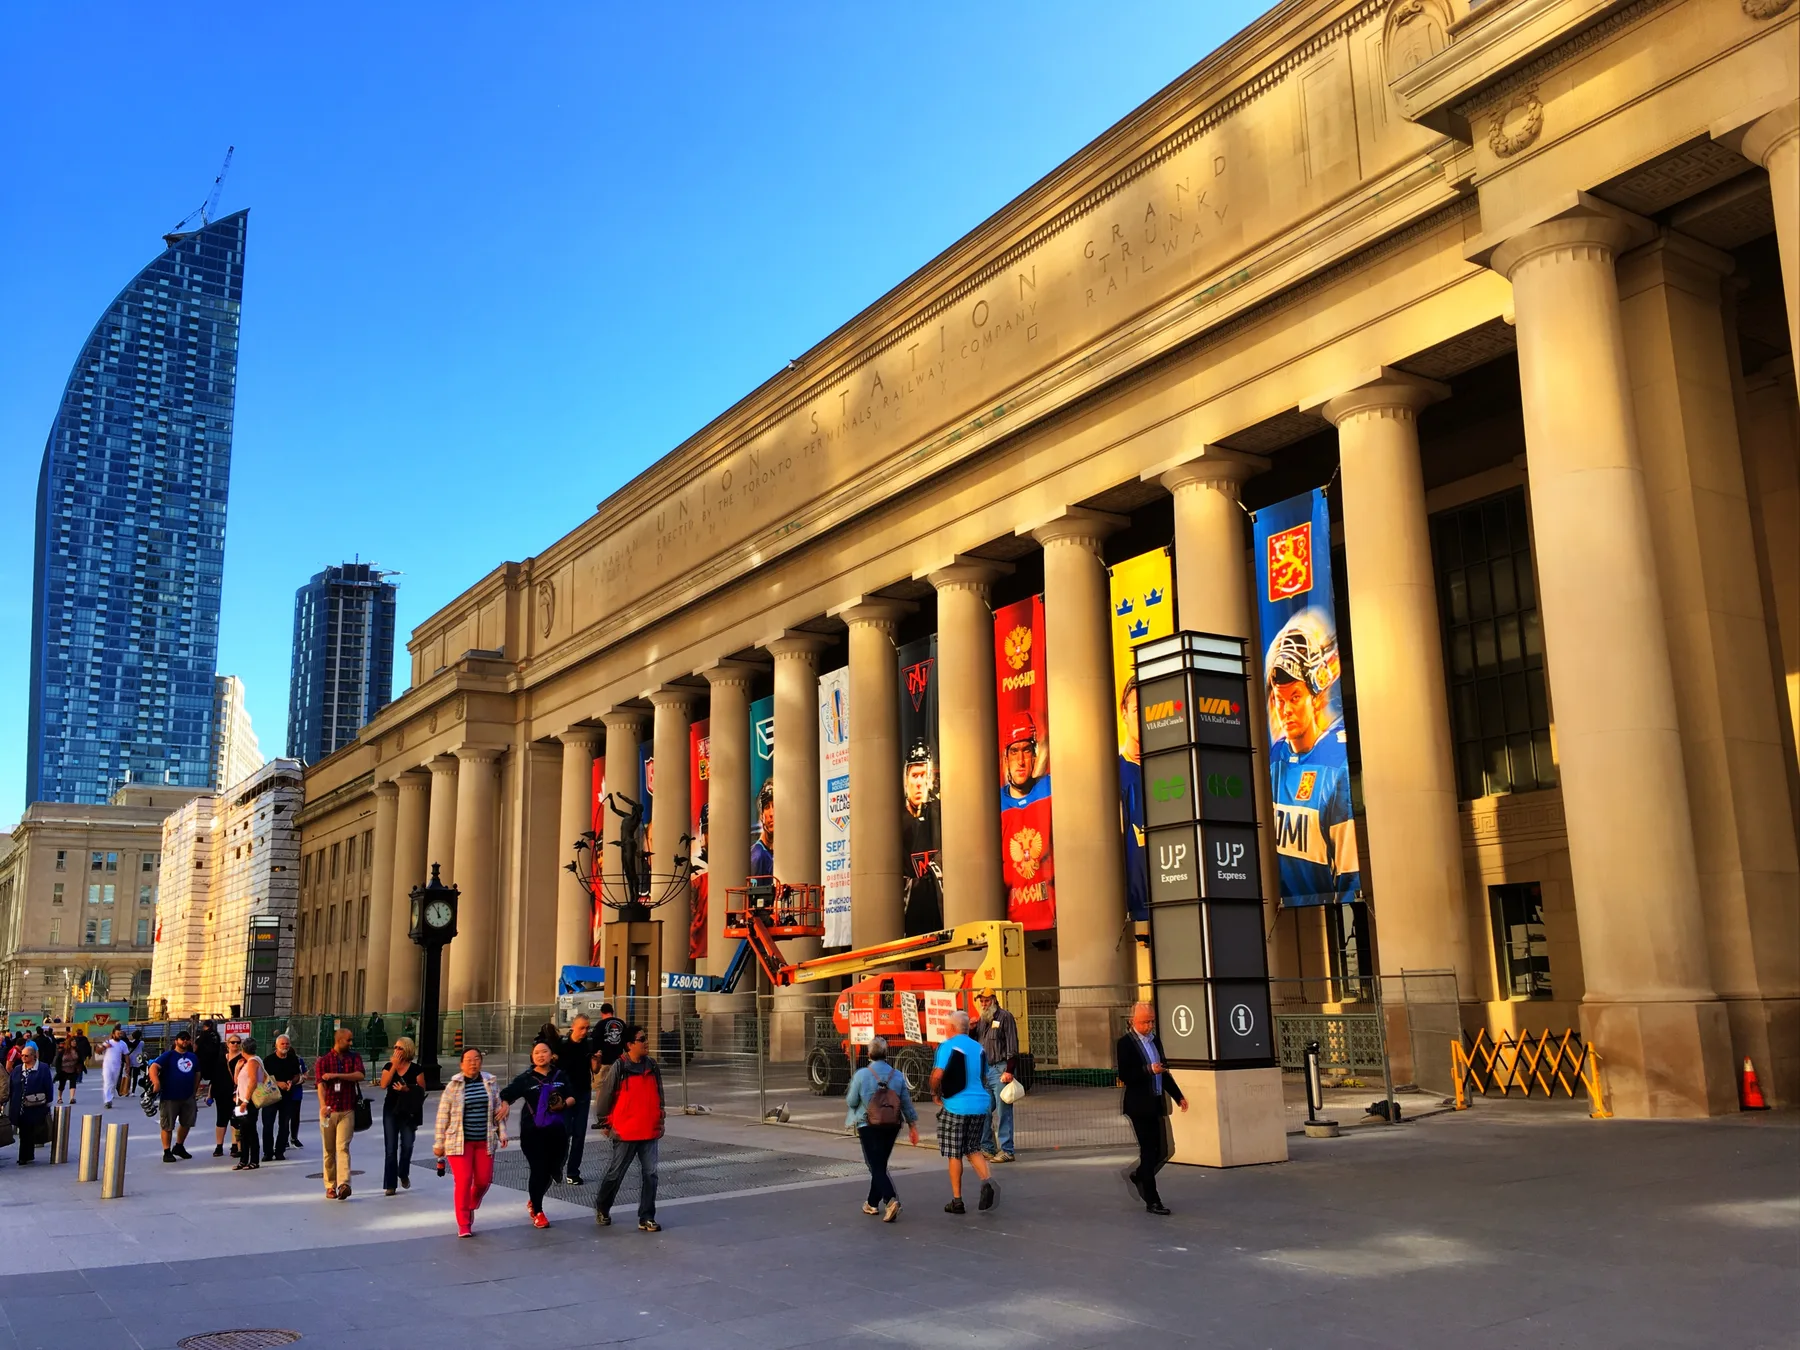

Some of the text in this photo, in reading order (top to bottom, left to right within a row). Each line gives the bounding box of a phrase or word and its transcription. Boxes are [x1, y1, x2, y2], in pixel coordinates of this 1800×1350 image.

[1083, 155, 1226, 259] GRAND
[1098, 190, 1212, 273] TRUNK
[1085, 203, 1229, 308] RAILWAY
[656, 448, 760, 533] UNION
[810, 264, 1037, 435] STATION
[718, 493, 734, 511] THE
[742, 456, 793, 497] TORONTO
[802, 405, 873, 458] TERMINALS
[883, 360, 946, 408] RAILWAY
[960, 300, 1038, 359] COMPANY
[1145, 700, 1175, 722] VIA
[1199, 696, 1231, 716] VIA
[1200, 714, 1212, 722] VIA
[1146, 722, 1157, 731] VIA
[836, 793, 848, 804] FAN
[825, 839, 846, 853] SEPT
[1160, 843, 1187, 870] UP
[1216, 842, 1245, 867] UP
[825, 858, 846, 872] SEPT
[1161, 873, 1188, 884] Express
[1217, 870, 1247, 881] Express
[672, 974, 704, 989] Z-80/60
[851, 1011, 872, 1025] DANGER
[226, 1023, 250, 1031] DANGER
